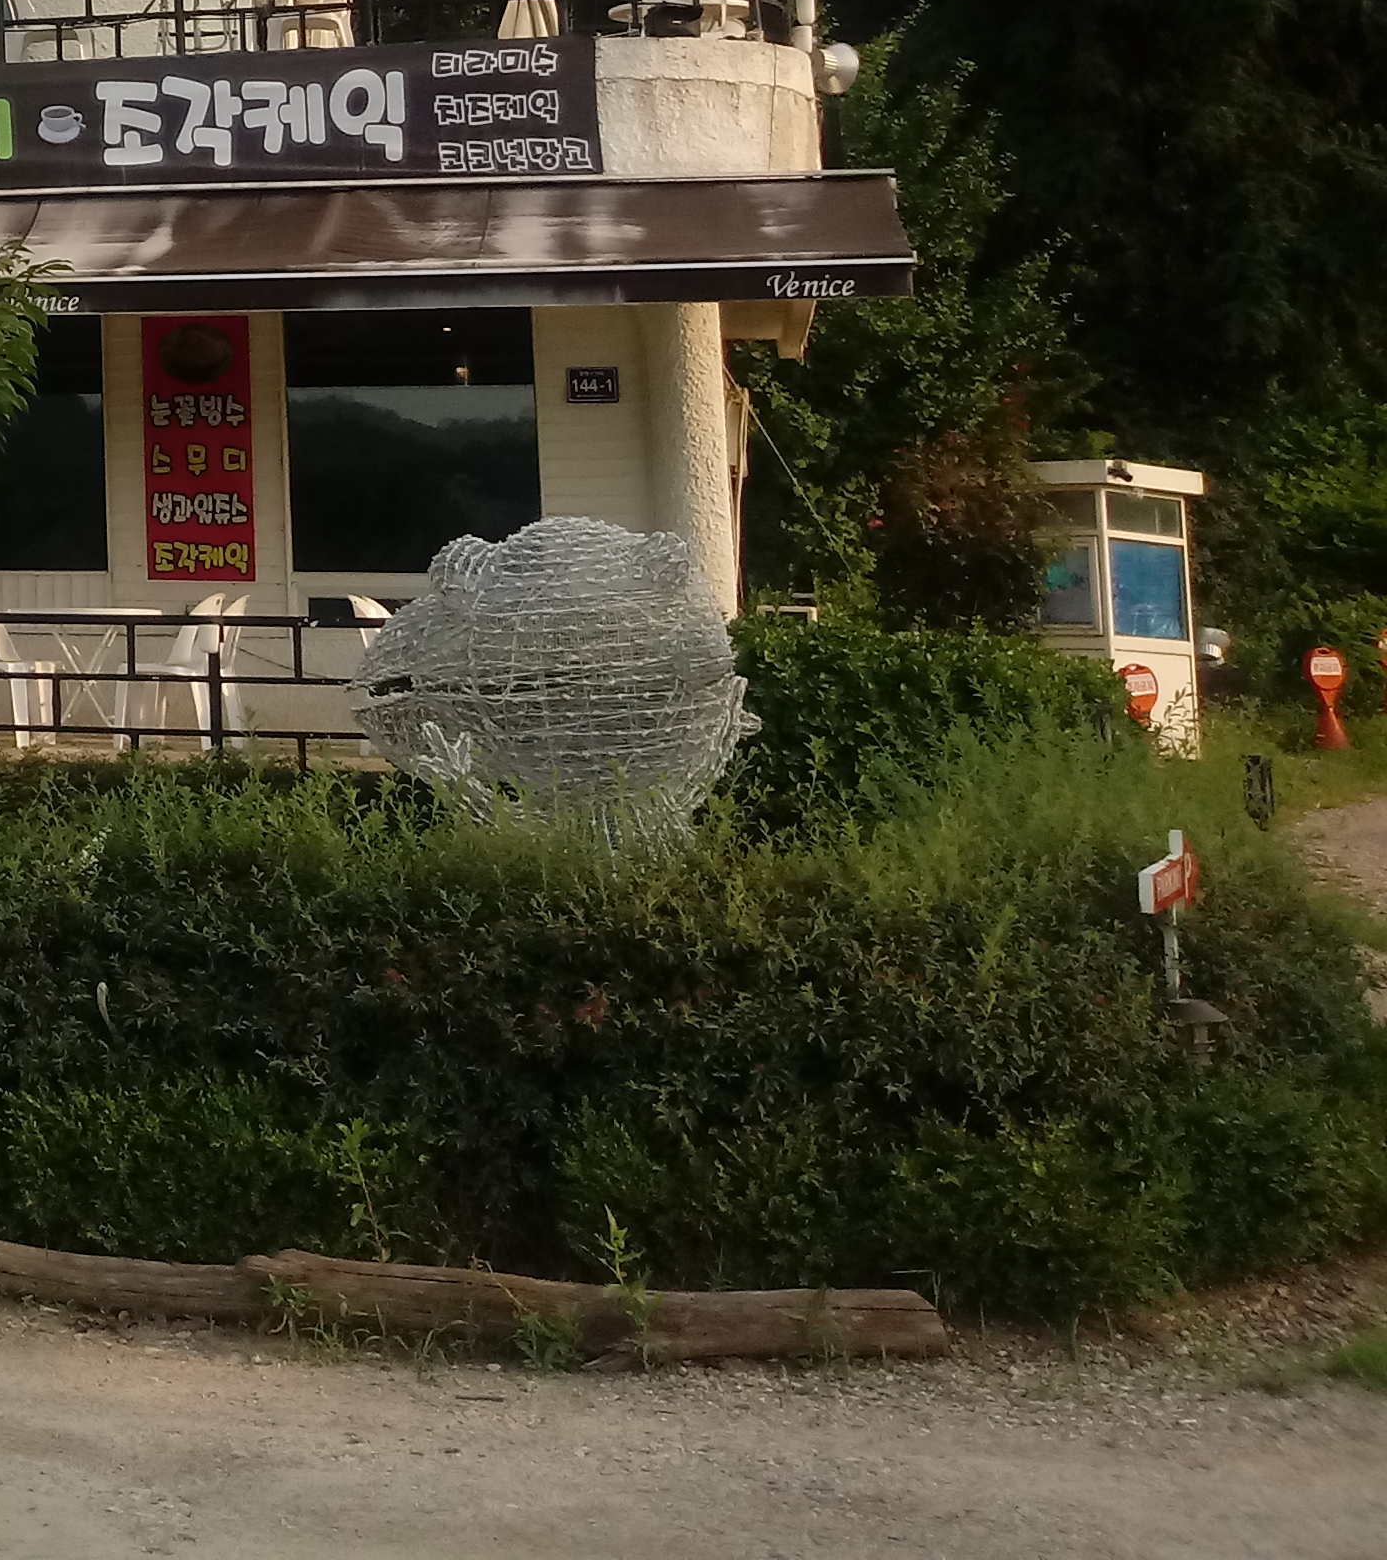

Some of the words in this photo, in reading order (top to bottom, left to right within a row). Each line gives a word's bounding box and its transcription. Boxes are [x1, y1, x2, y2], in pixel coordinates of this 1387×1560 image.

[432, 43, 559, 77] 티라미수
[95, 67, 407, 168] 조각케익
[434, 90, 560, 125] 치즈케익
[438, 137, 594, 173] 코코넛망고
[765, 270, 856, 298] Venice
[571, 378, 613, 393] 144-1
[150, 394, 245, 427] 눈꽃빙수
[152, 493, 248, 524] 생과일쥬스
[153, 542, 249, 573] 조각케익
